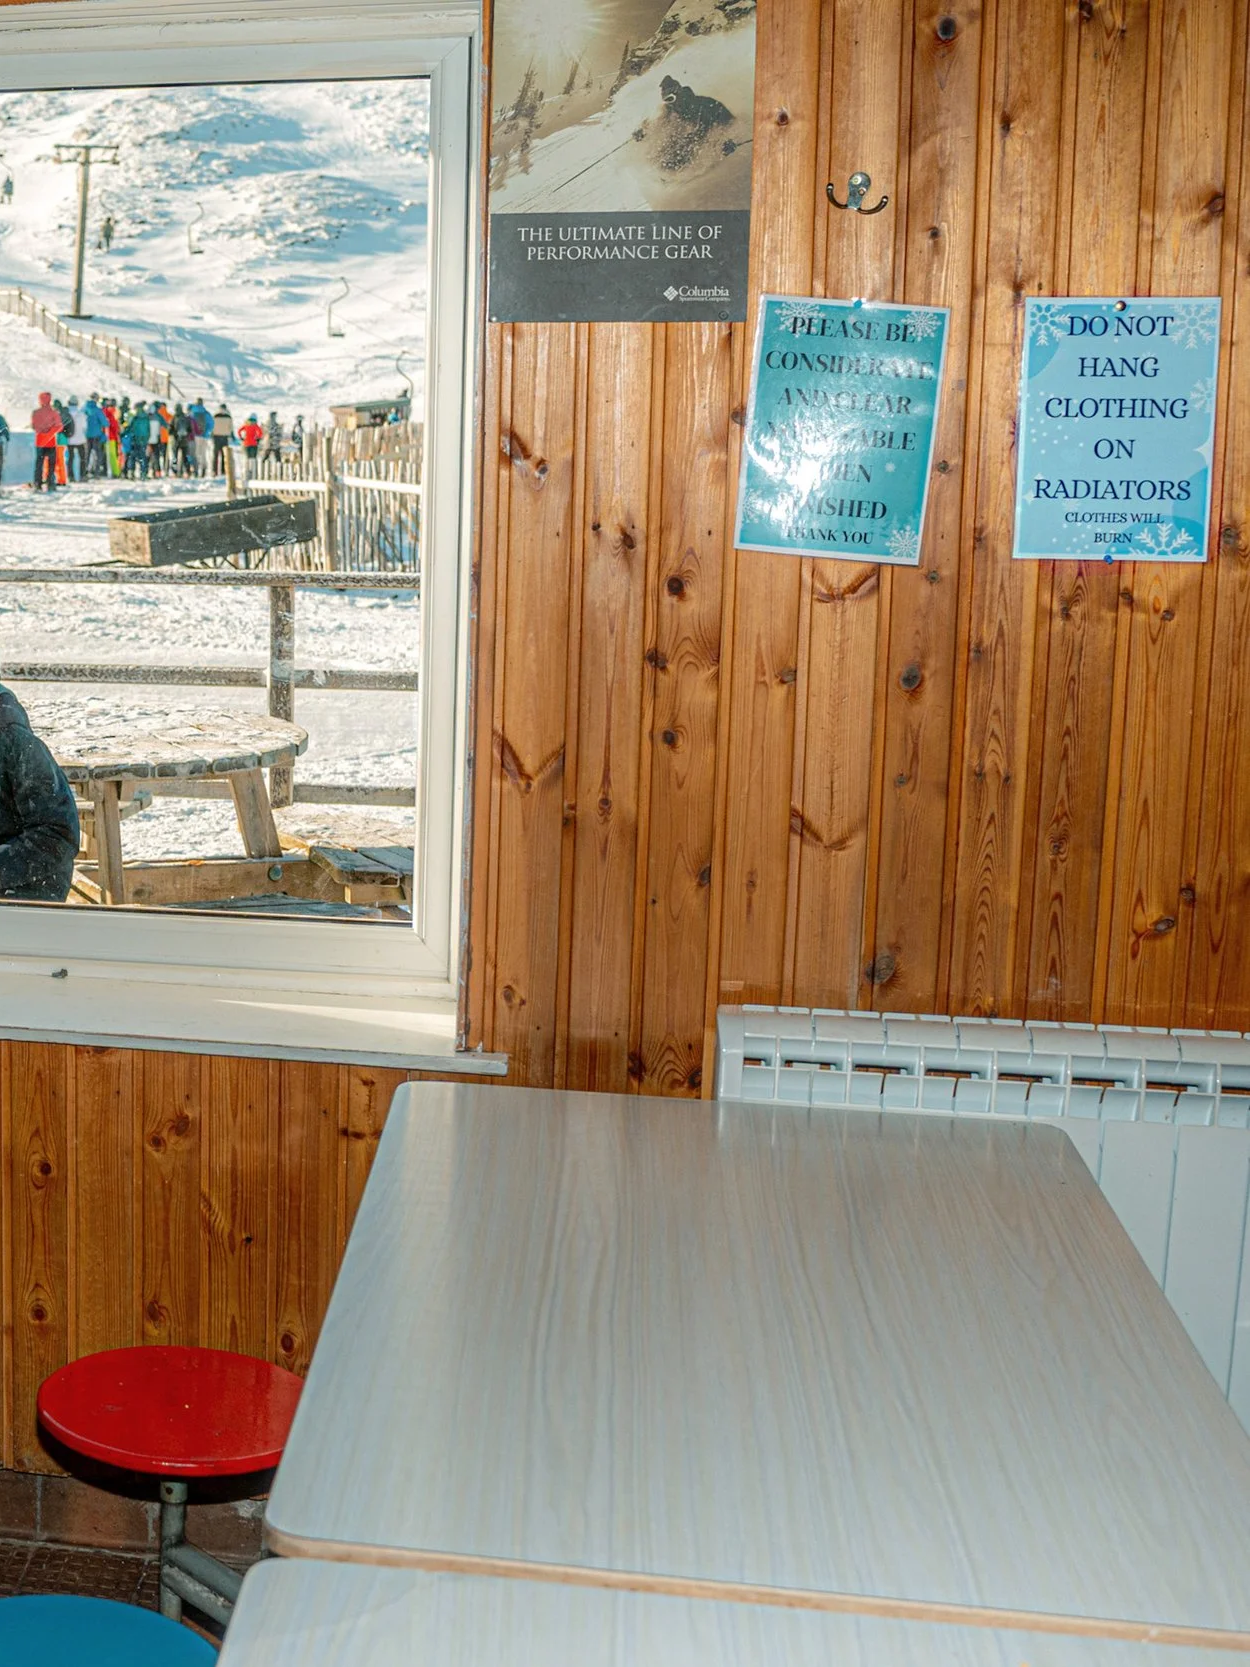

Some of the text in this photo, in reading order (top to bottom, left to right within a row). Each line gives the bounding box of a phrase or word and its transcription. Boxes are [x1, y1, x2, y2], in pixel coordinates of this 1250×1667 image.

[518, 225, 722, 242] THE ULTIMATE LINE OF
[527, 245, 713, 261] PERFORMANCE GEAR
[679, 286, 729, 297] Columbia
[791, 316, 916, 343] PLEASE BE
[1067, 316, 1174, 337] DO NOT
[765, 350, 934, 381] CONSIDERATE
[1078, 357, 1160, 377] HANG
[777, 387, 911, 415] AND CLEAR
[1045, 398, 1189, 419] CLOTHING
[848, 428, 916, 451] ABLE
[1094, 438, 1135, 460] ON
[1034, 479, 1191, 501] RADIATORS
[1065, 512, 1165, 524] CLOTHES WILL
[843, 530, 874, 545] YOU
[1094, 532, 1132, 543] BURN
